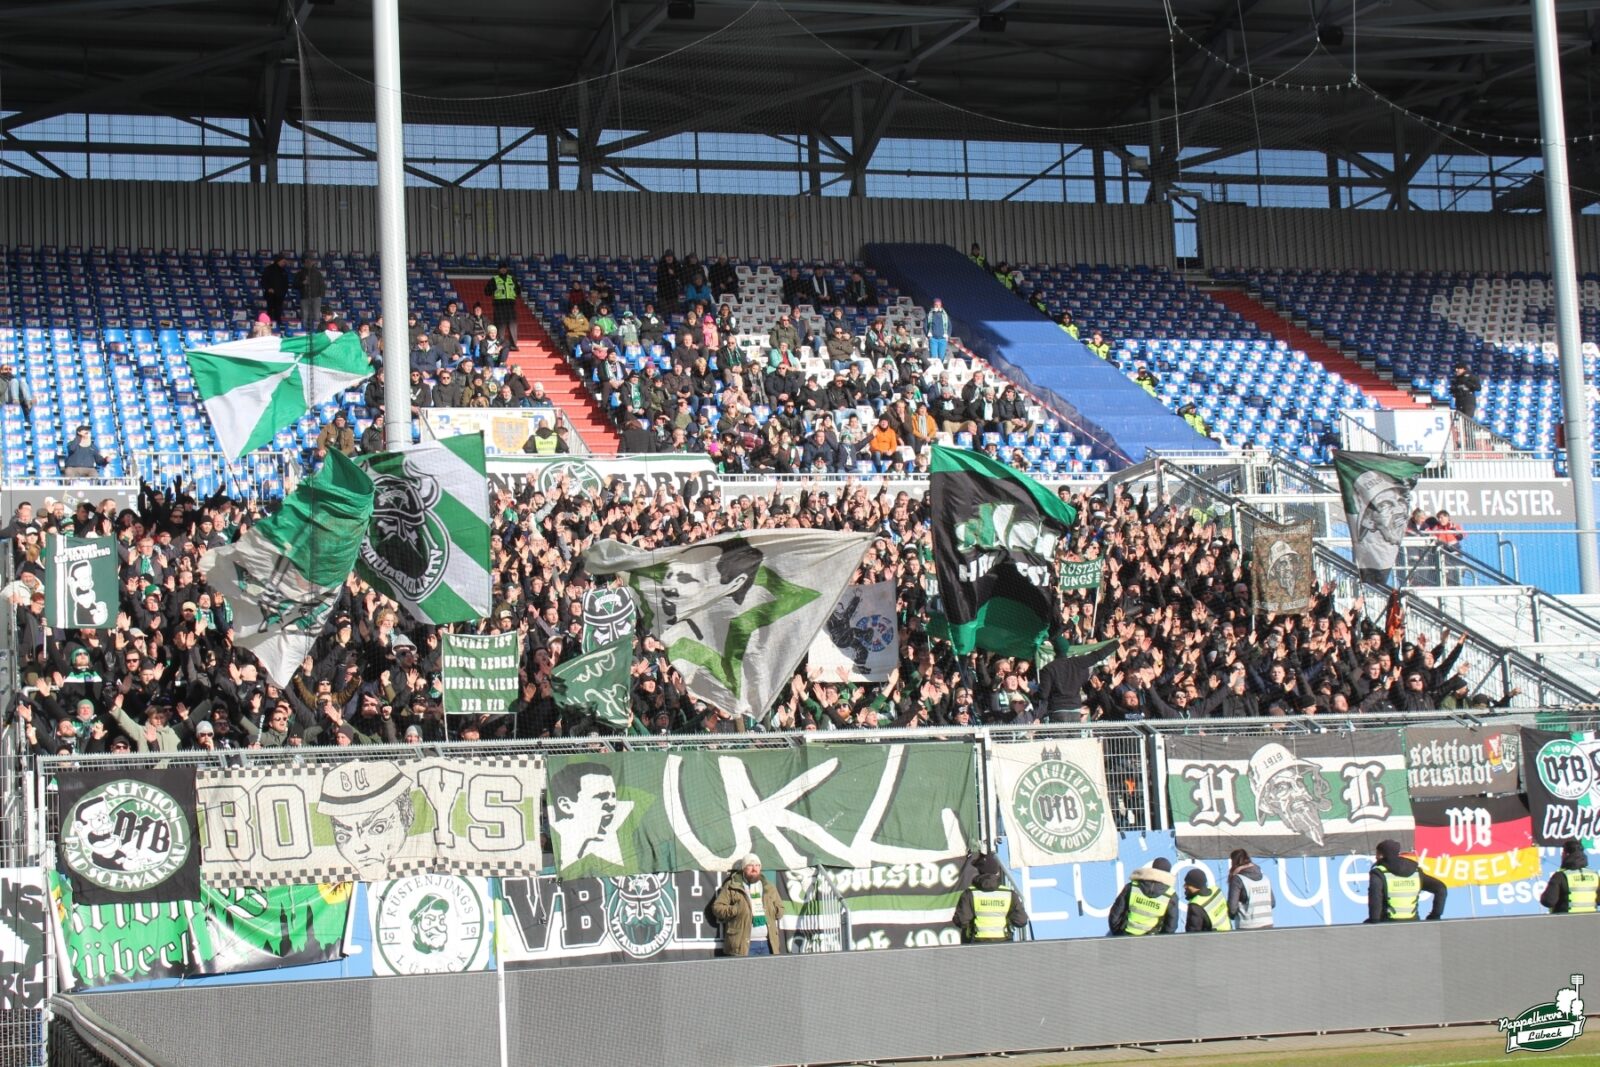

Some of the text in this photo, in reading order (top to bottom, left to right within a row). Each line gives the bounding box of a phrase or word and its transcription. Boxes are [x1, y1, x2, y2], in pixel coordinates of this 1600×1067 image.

[1481, 490, 1562, 516] FASTER.
[1060, 572, 1094, 587] JUNGS
[461, 698, 481, 711] DER
[1410, 738, 1485, 768] sektion
[340, 769, 370, 793] BU
[1407, 762, 1494, 788] neustadt
[104, 782, 183, 822] SEKTION
[662, 744, 968, 873] UKL
[64, 836, 89, 871] BAD
[1416, 848, 1523, 882] LÜBECK
[386, 875, 474, 919] KÜSTENJUNGS
[383, 926, 477, 943] 19 19
